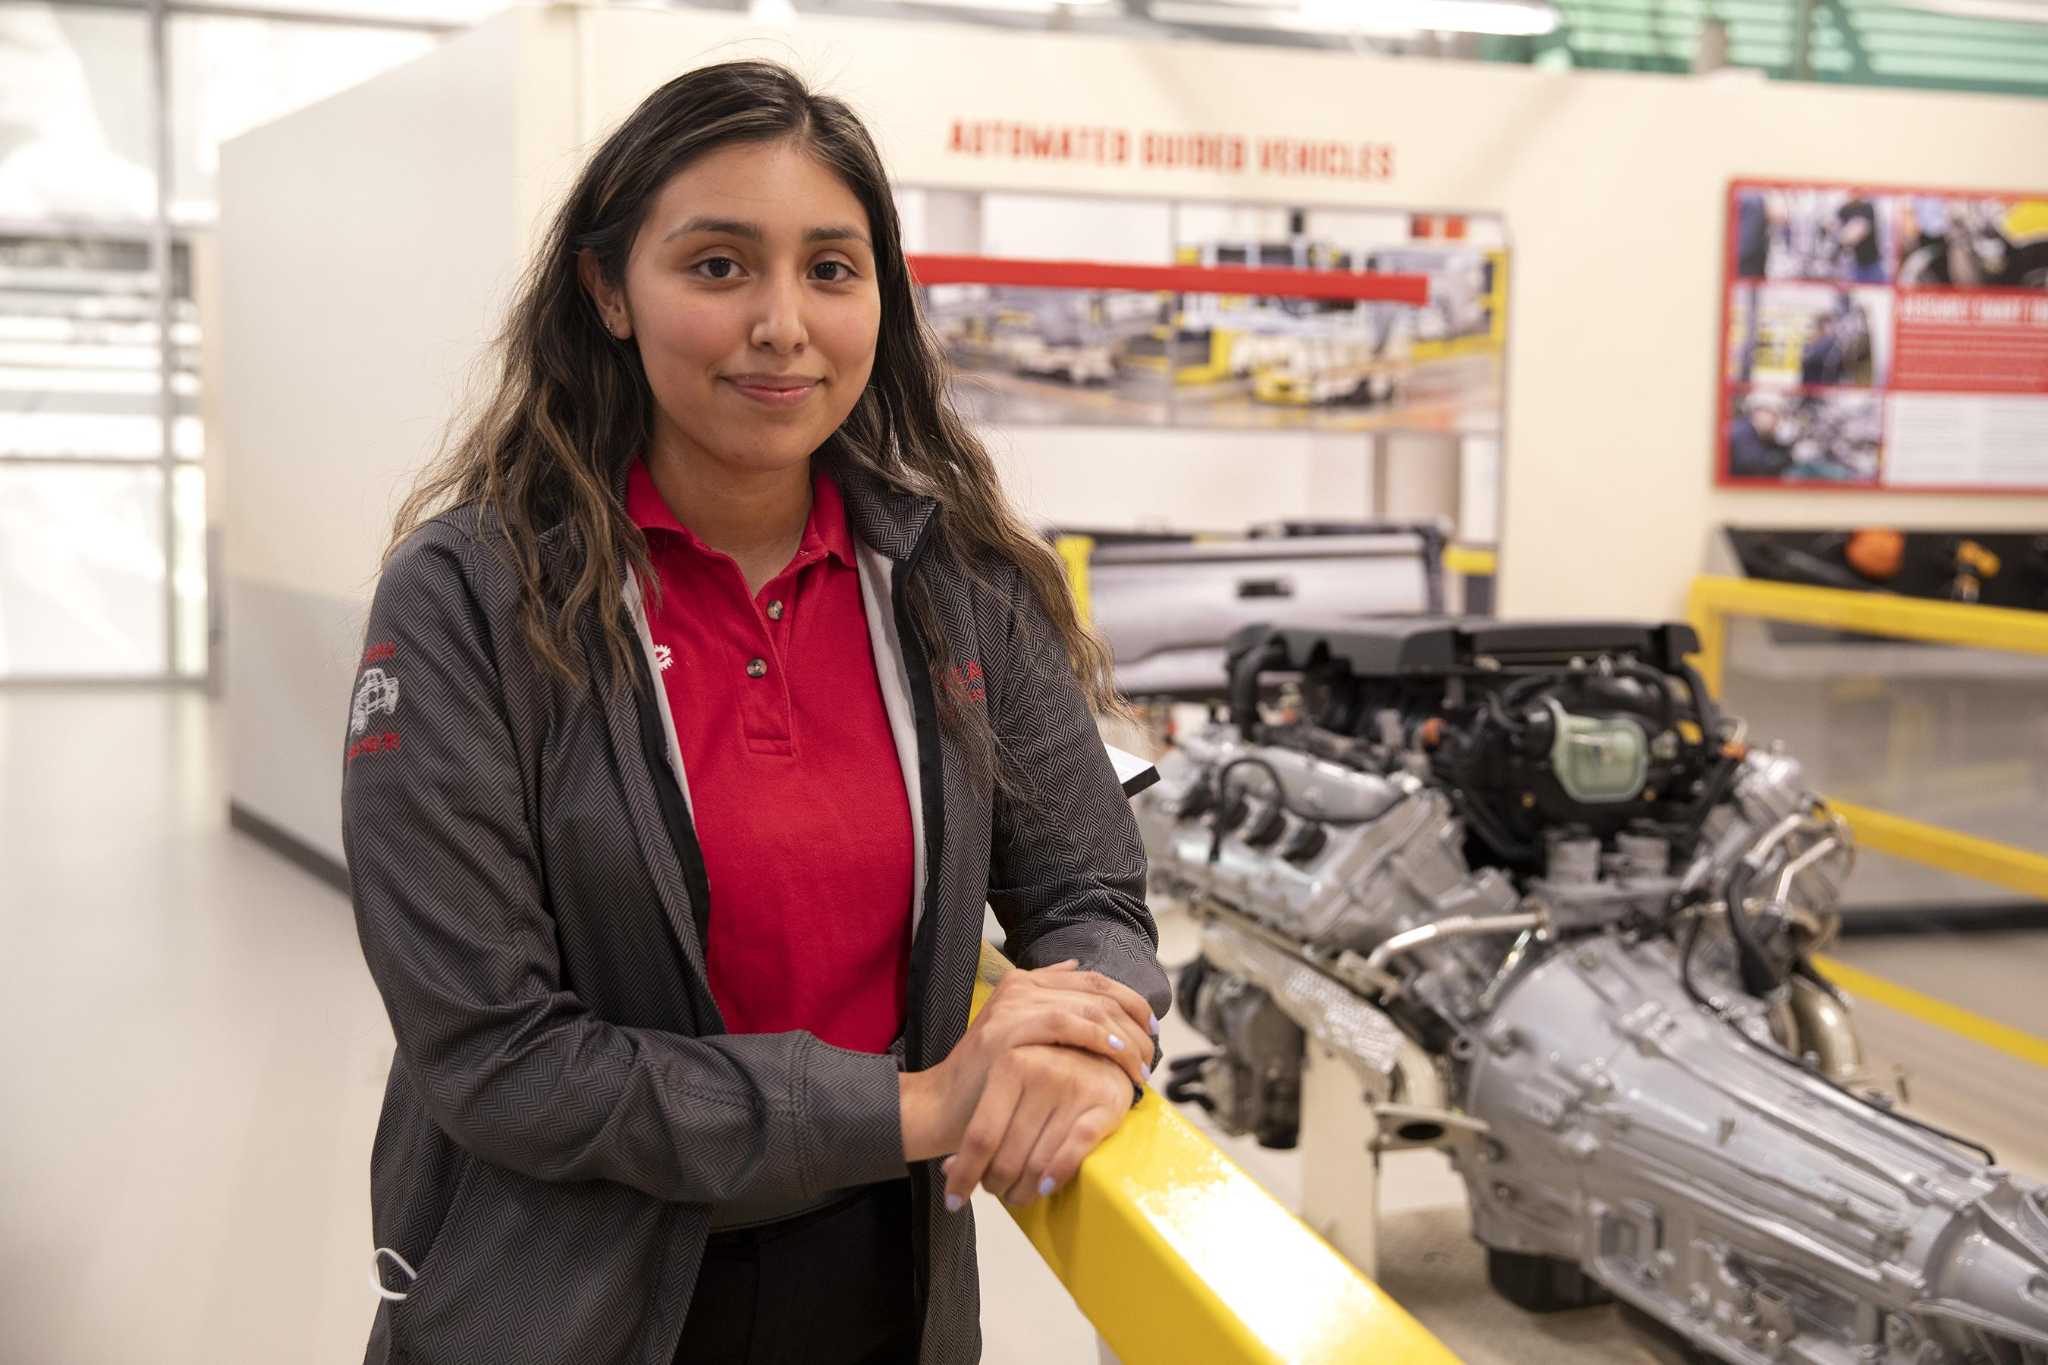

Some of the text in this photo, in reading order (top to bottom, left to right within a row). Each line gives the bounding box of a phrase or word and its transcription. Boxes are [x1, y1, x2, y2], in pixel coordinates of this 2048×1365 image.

[949, 119, 1394, 180] AUTOMATED GUIDED VEHICLES
